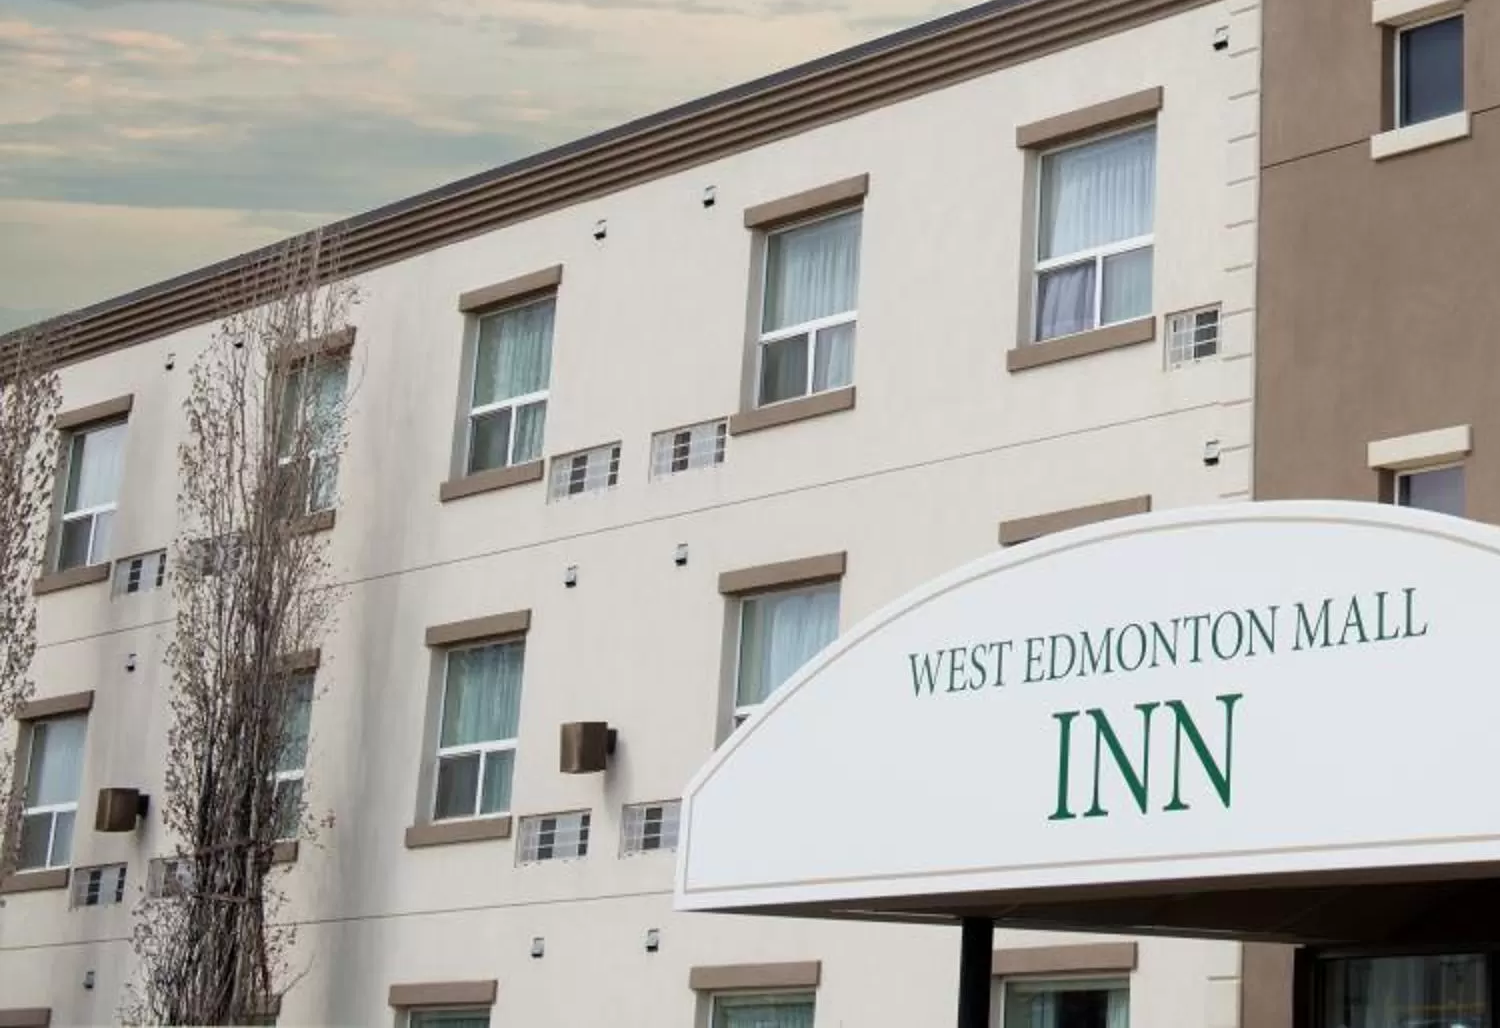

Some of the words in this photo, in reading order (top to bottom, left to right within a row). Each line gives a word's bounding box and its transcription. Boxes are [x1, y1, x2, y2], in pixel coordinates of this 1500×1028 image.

[909, 640, 1012, 697] WEST
[1024, 606, 1280, 683] EDMONTON
[1292, 588, 1428, 651] MALL
[1048, 693, 1243, 820] INN
